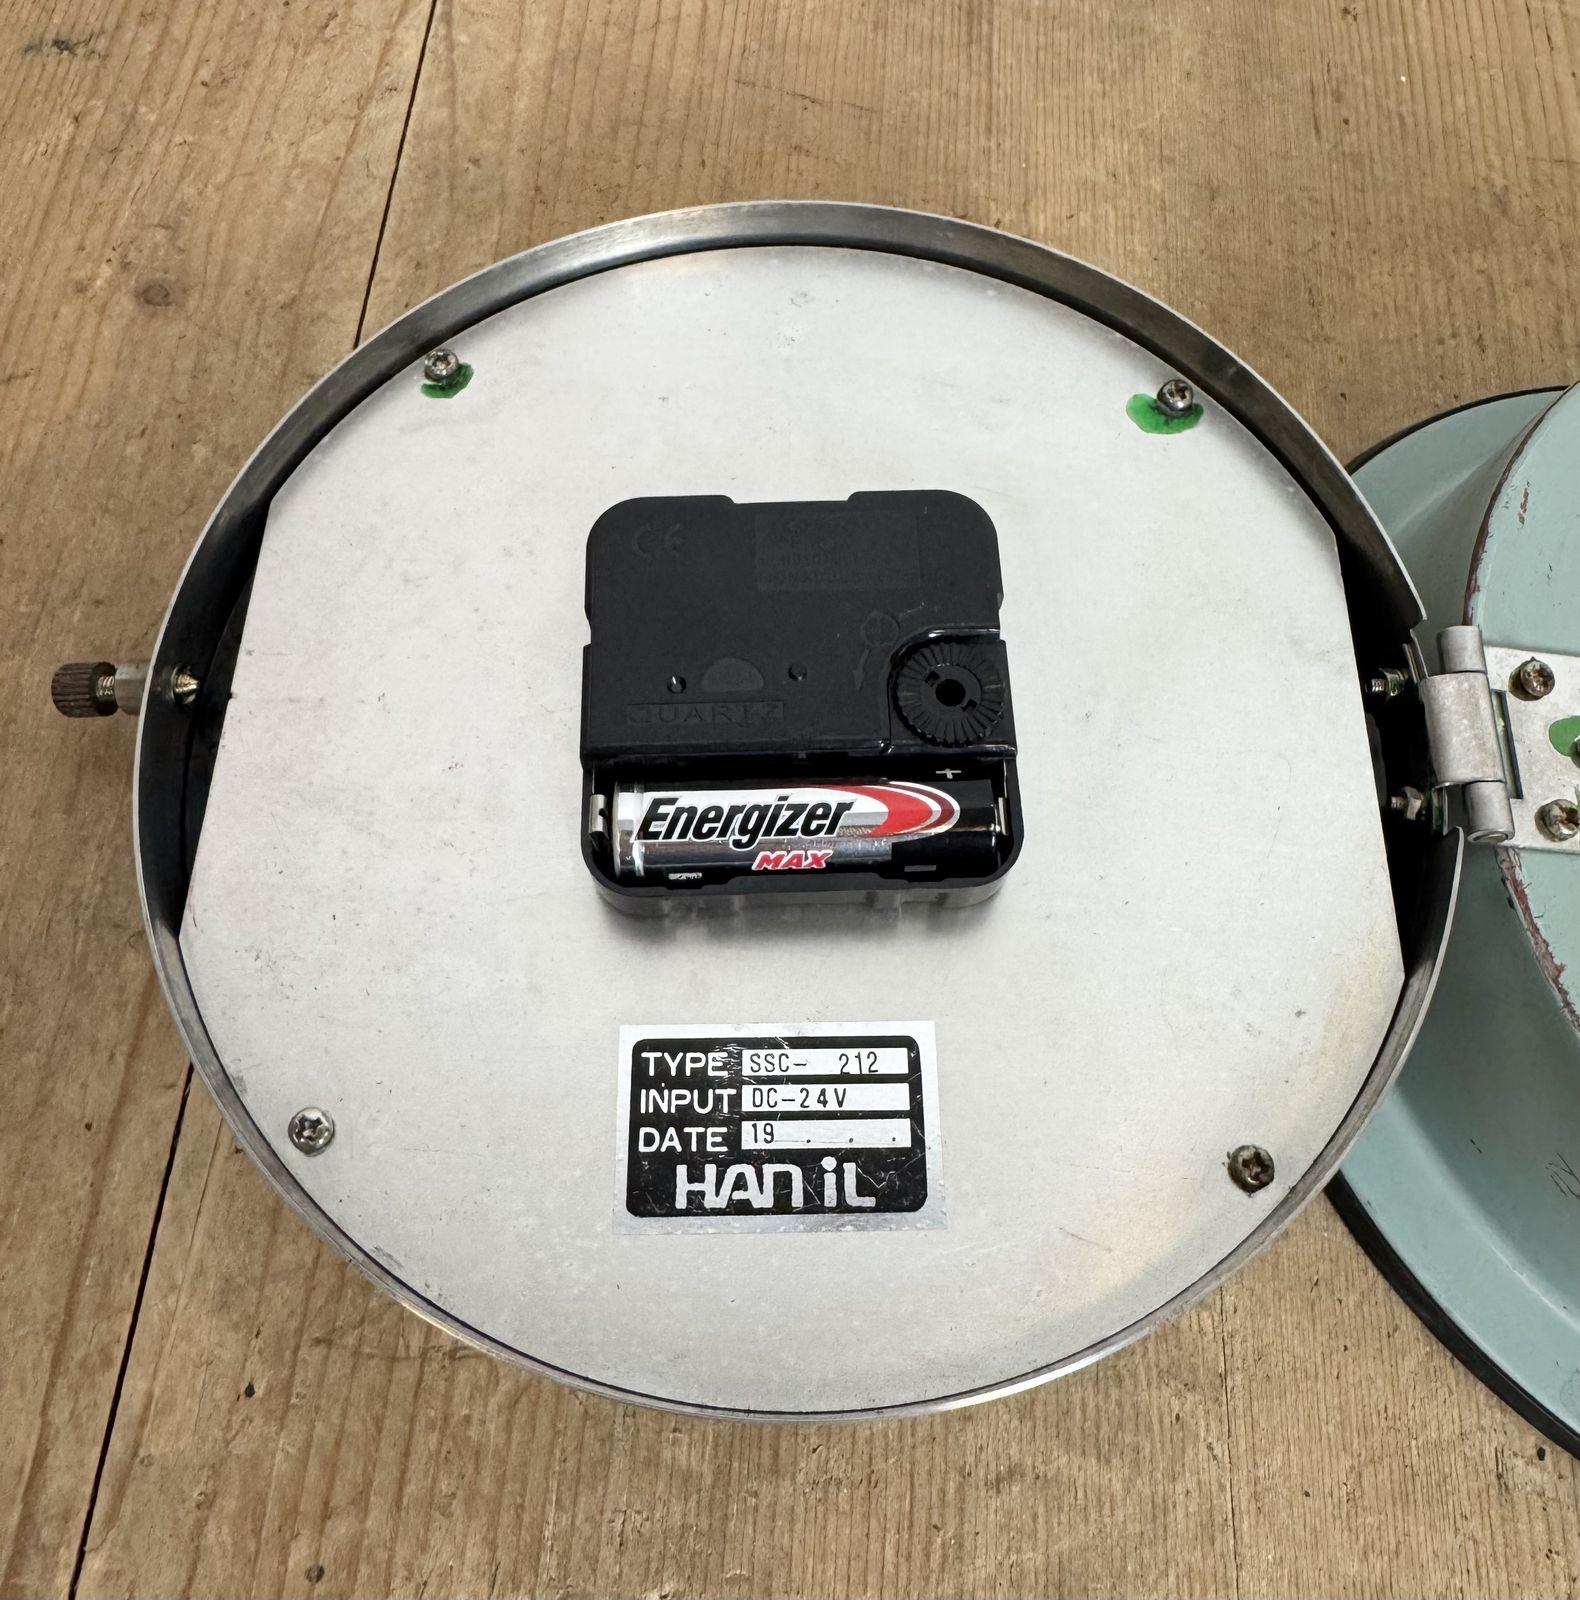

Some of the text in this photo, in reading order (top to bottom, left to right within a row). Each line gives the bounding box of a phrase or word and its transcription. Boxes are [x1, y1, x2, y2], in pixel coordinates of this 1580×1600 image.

[628, 703, 783, 724] QUARTZ
[635, 794, 856, 851] Energizer
[752, 851, 833, 871] MAX
[640, 1051, 729, 1077] TYPE
[838, 1051, 879, 1075] 212
[640, 1087, 847, 1114] INPUT DC-24V
[638, 1126, 729, 1152] DATE
